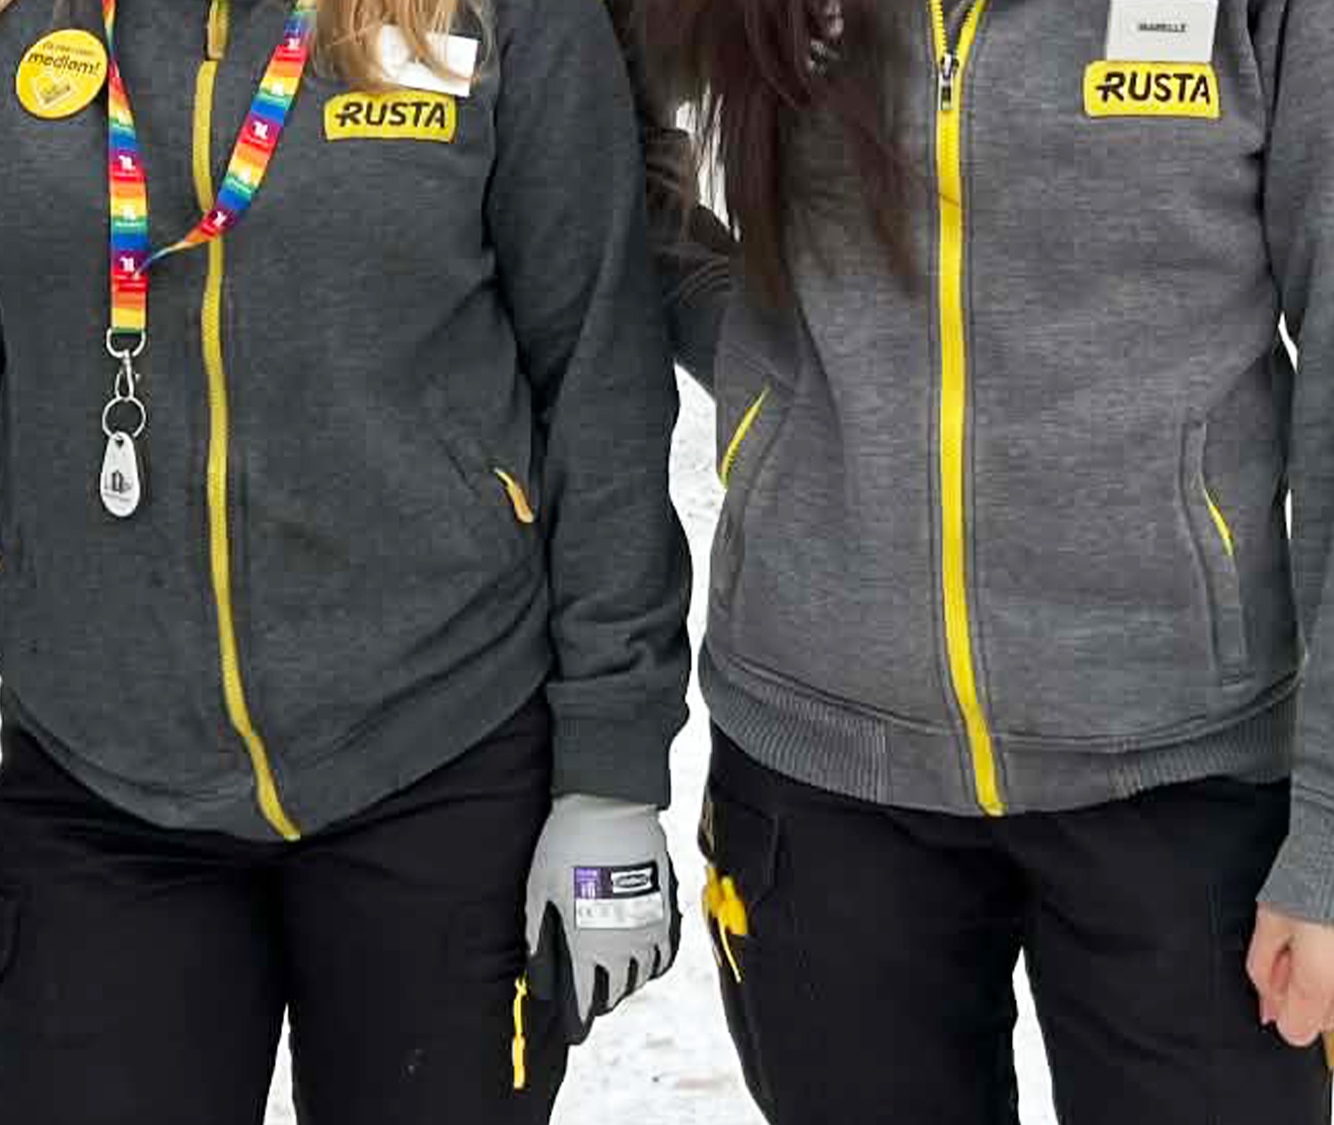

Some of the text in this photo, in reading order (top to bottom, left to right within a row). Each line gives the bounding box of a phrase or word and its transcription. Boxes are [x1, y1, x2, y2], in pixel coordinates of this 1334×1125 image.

[28, 52, 102, 77] medlem!
[1096, 71, 1211, 105] RUSTA
[335, 101, 447, 129] RUSTA
